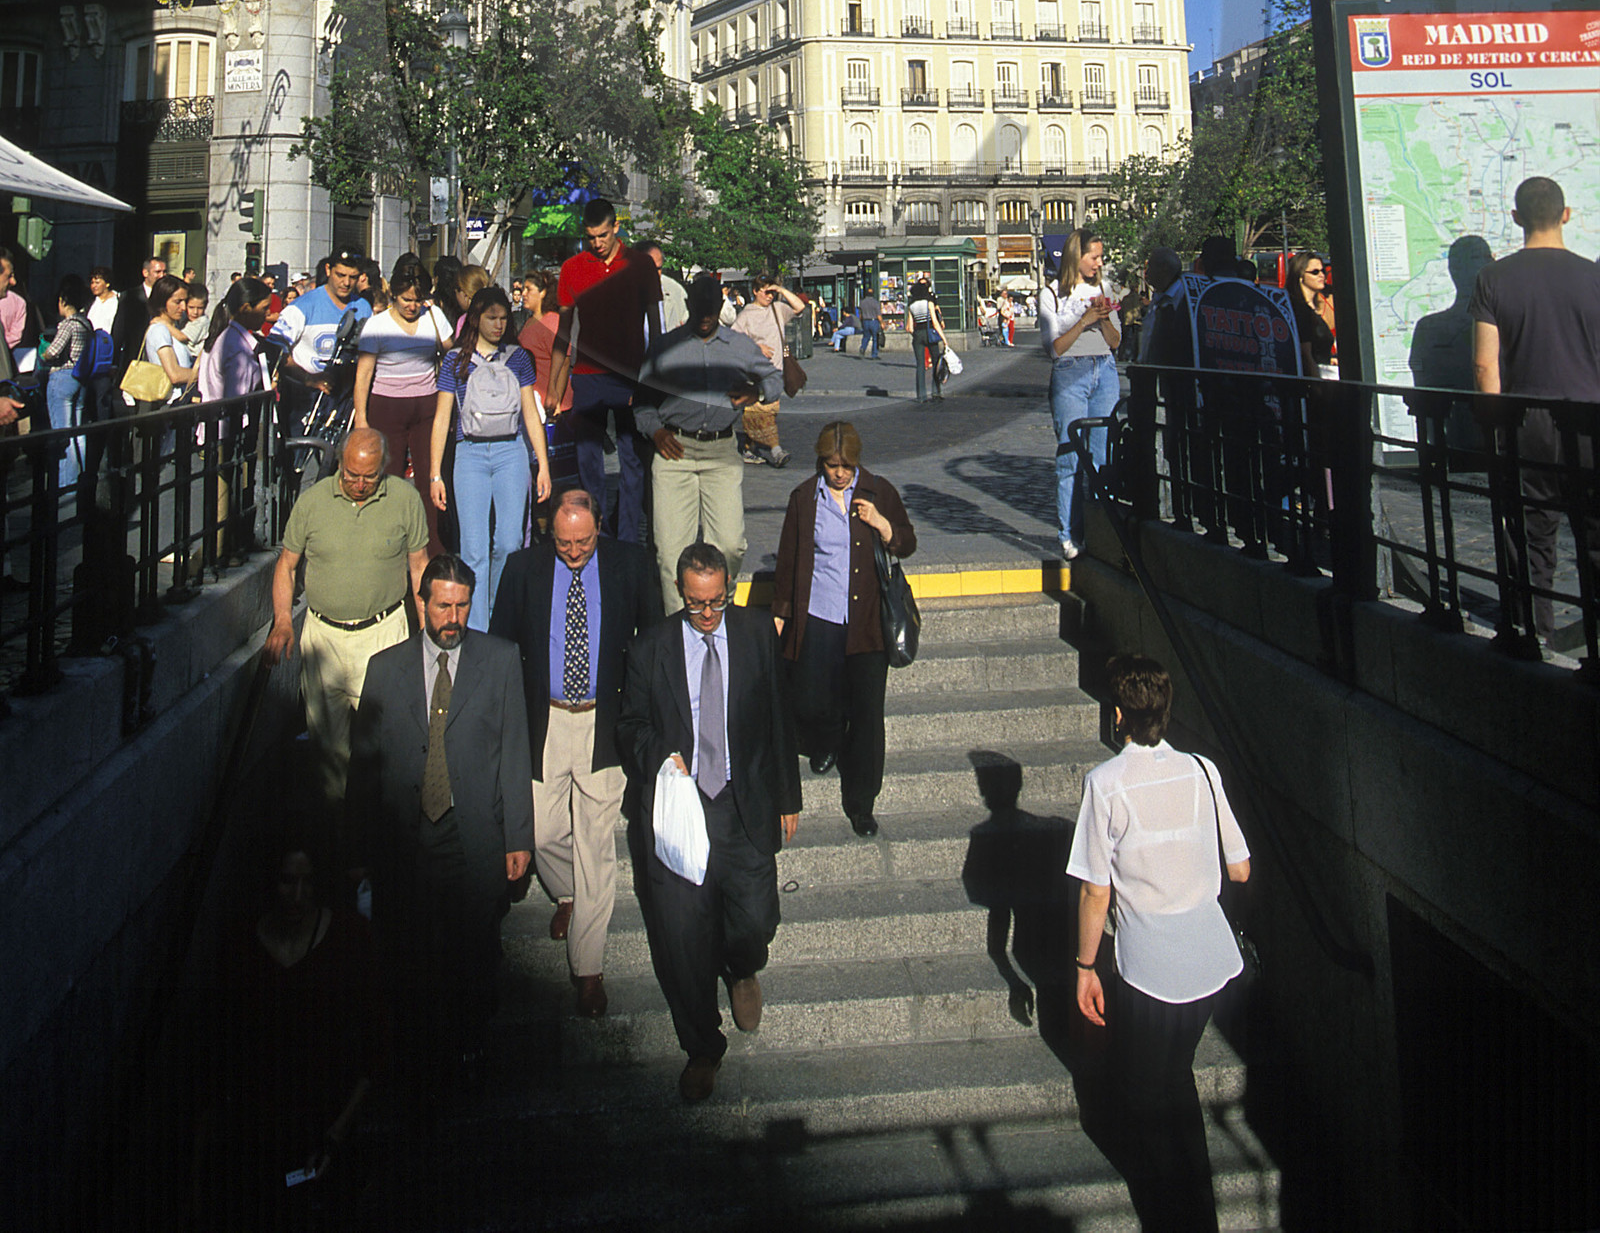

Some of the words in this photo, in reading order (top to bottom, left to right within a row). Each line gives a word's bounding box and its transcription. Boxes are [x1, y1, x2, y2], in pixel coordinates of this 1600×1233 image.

[1424, 23, 1549, 45] MADRID
[1402, 54, 1436, 66] RED
[1441, 53, 1462, 65] DE
[1466, 52, 1522, 65] METRO
[1525, 52, 1537, 64] Y
[1470, 71, 1512, 88] SOL
[1201, 305, 1289, 342] TATTOO
[1206, 332, 1259, 355] STUDIO
